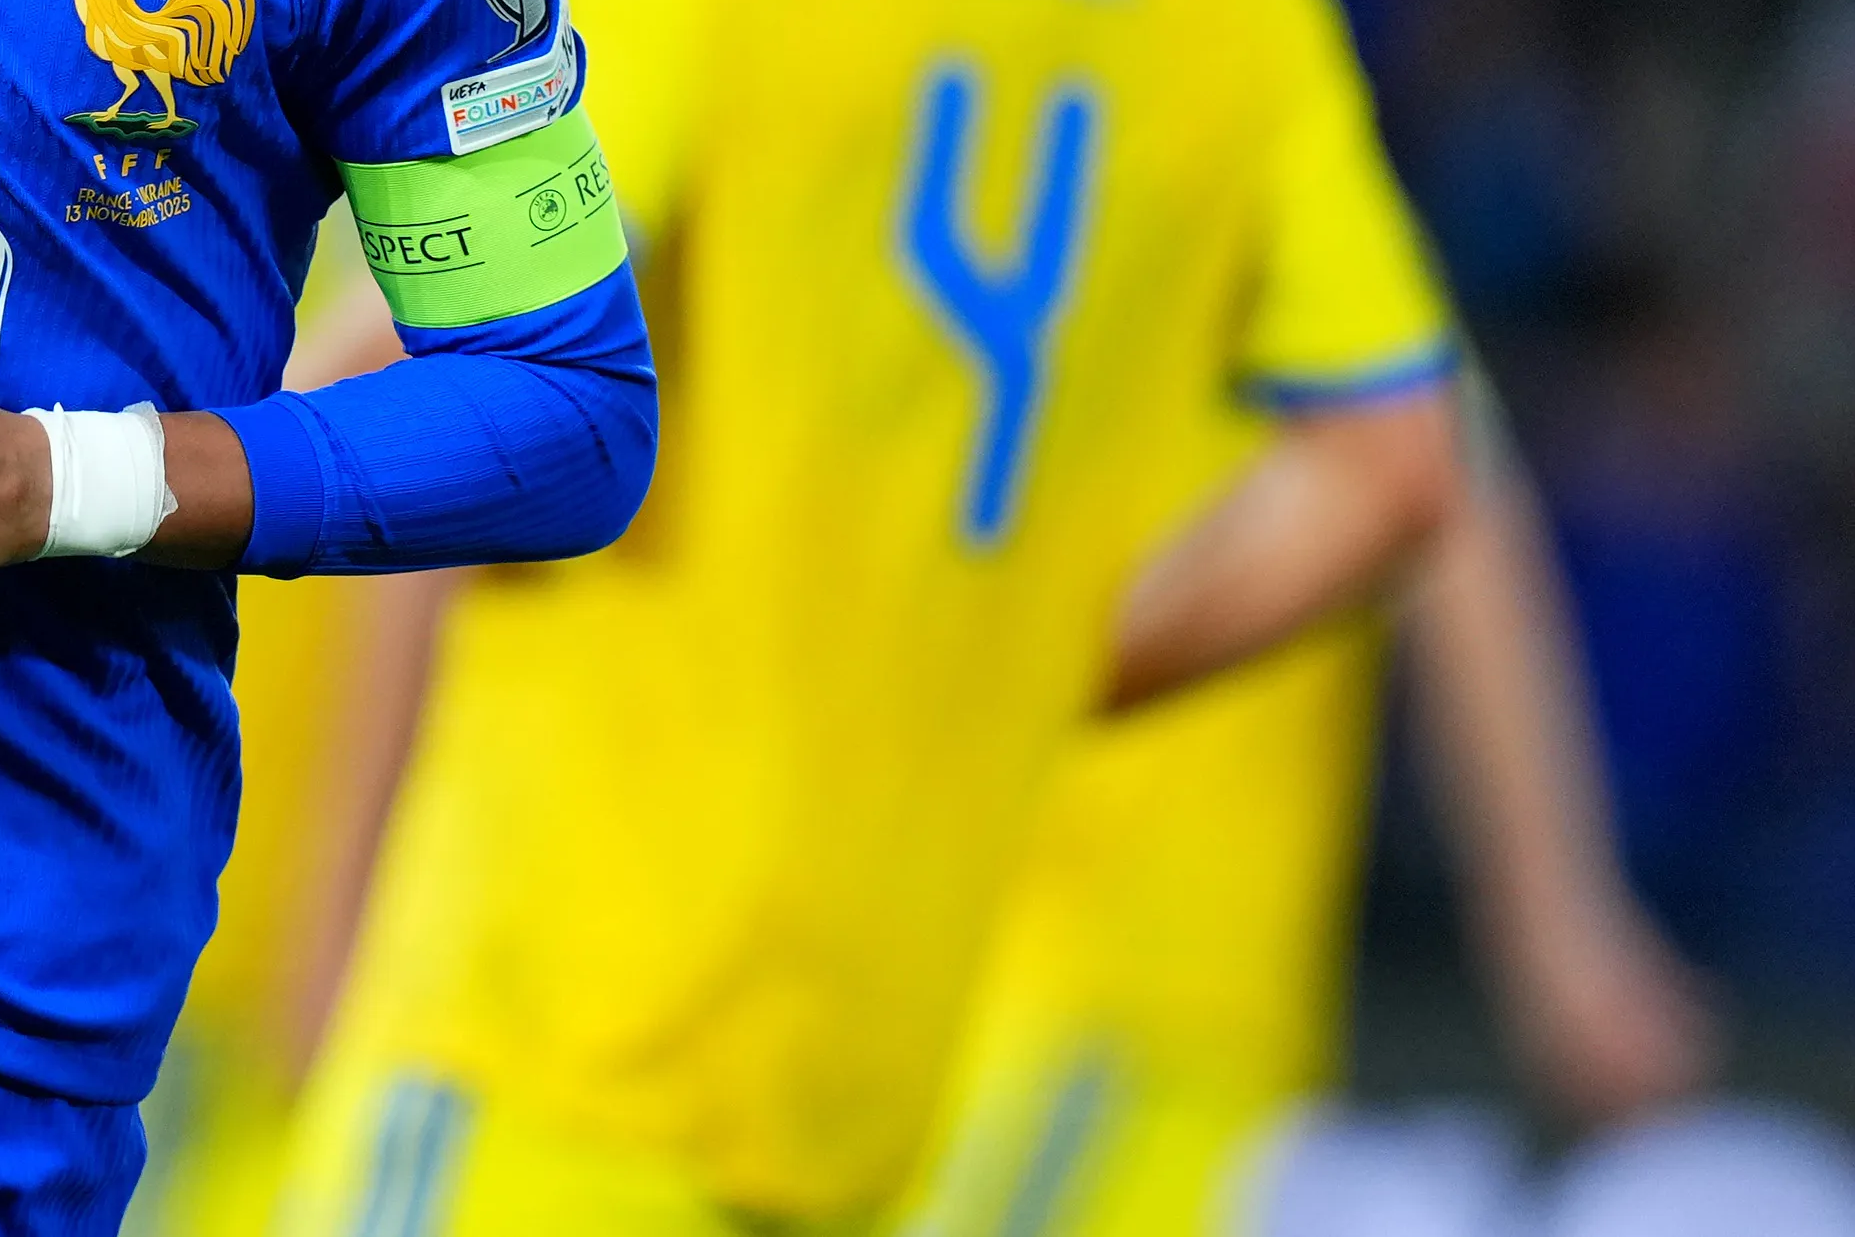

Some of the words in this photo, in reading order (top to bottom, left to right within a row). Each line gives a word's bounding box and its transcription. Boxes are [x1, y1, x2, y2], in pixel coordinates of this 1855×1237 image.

[448, 81, 487, 102] UEFA
[65, 204, 82, 223] 13
[85, 205, 160, 229] NOVEMBRE
[156, 193, 192, 222] 2025
[77, 187, 132, 211] FRANCE
[358, 226, 472, 265] SPECT
[901, 62, 1097, 547] 4
